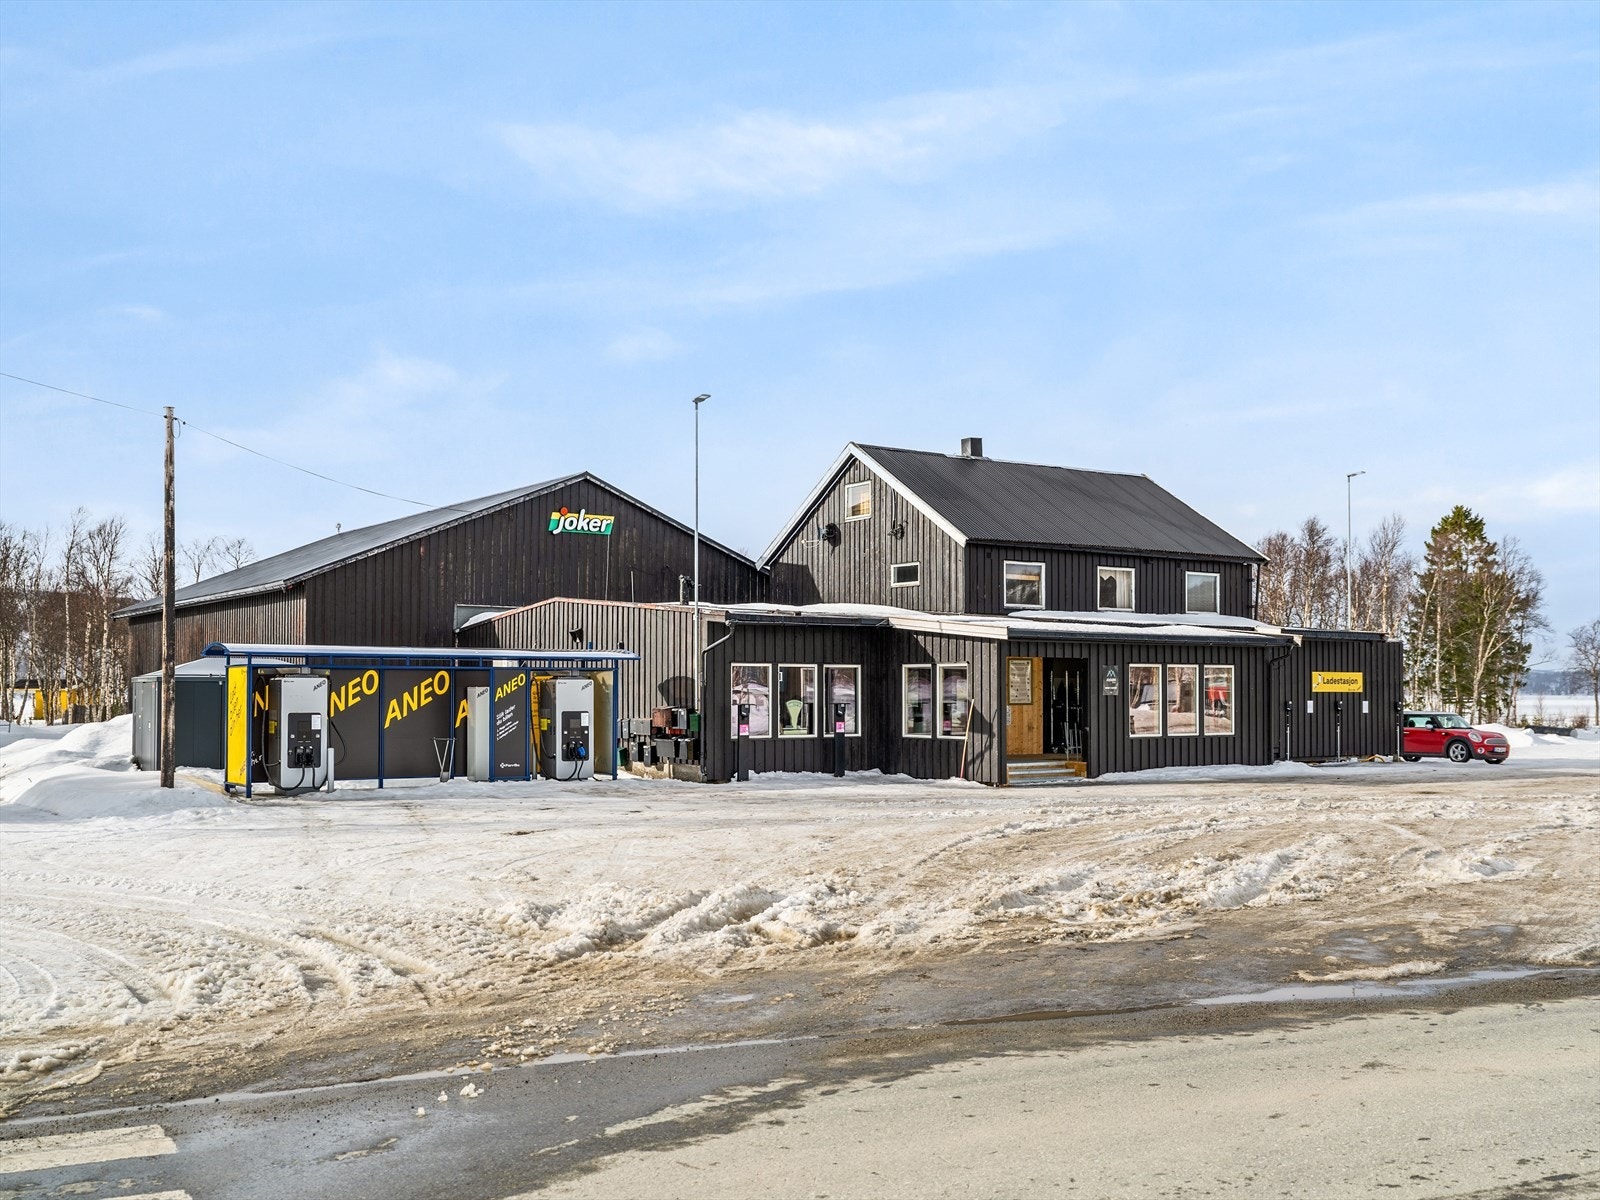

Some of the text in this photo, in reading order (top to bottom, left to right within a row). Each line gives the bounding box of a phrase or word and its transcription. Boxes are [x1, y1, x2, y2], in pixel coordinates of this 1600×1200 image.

[552, 506, 611, 535] joker
[313, 680, 326, 691] ANEO
[495, 673, 526, 702] ANEO
[581, 681, 592, 691] ANEO
[1322, 677, 1358, 686] Ladestasjon
[329, 670, 379, 718] NEO
[384, 670, 450, 729] ANEO
[477, 688, 488, 698] ANEO
